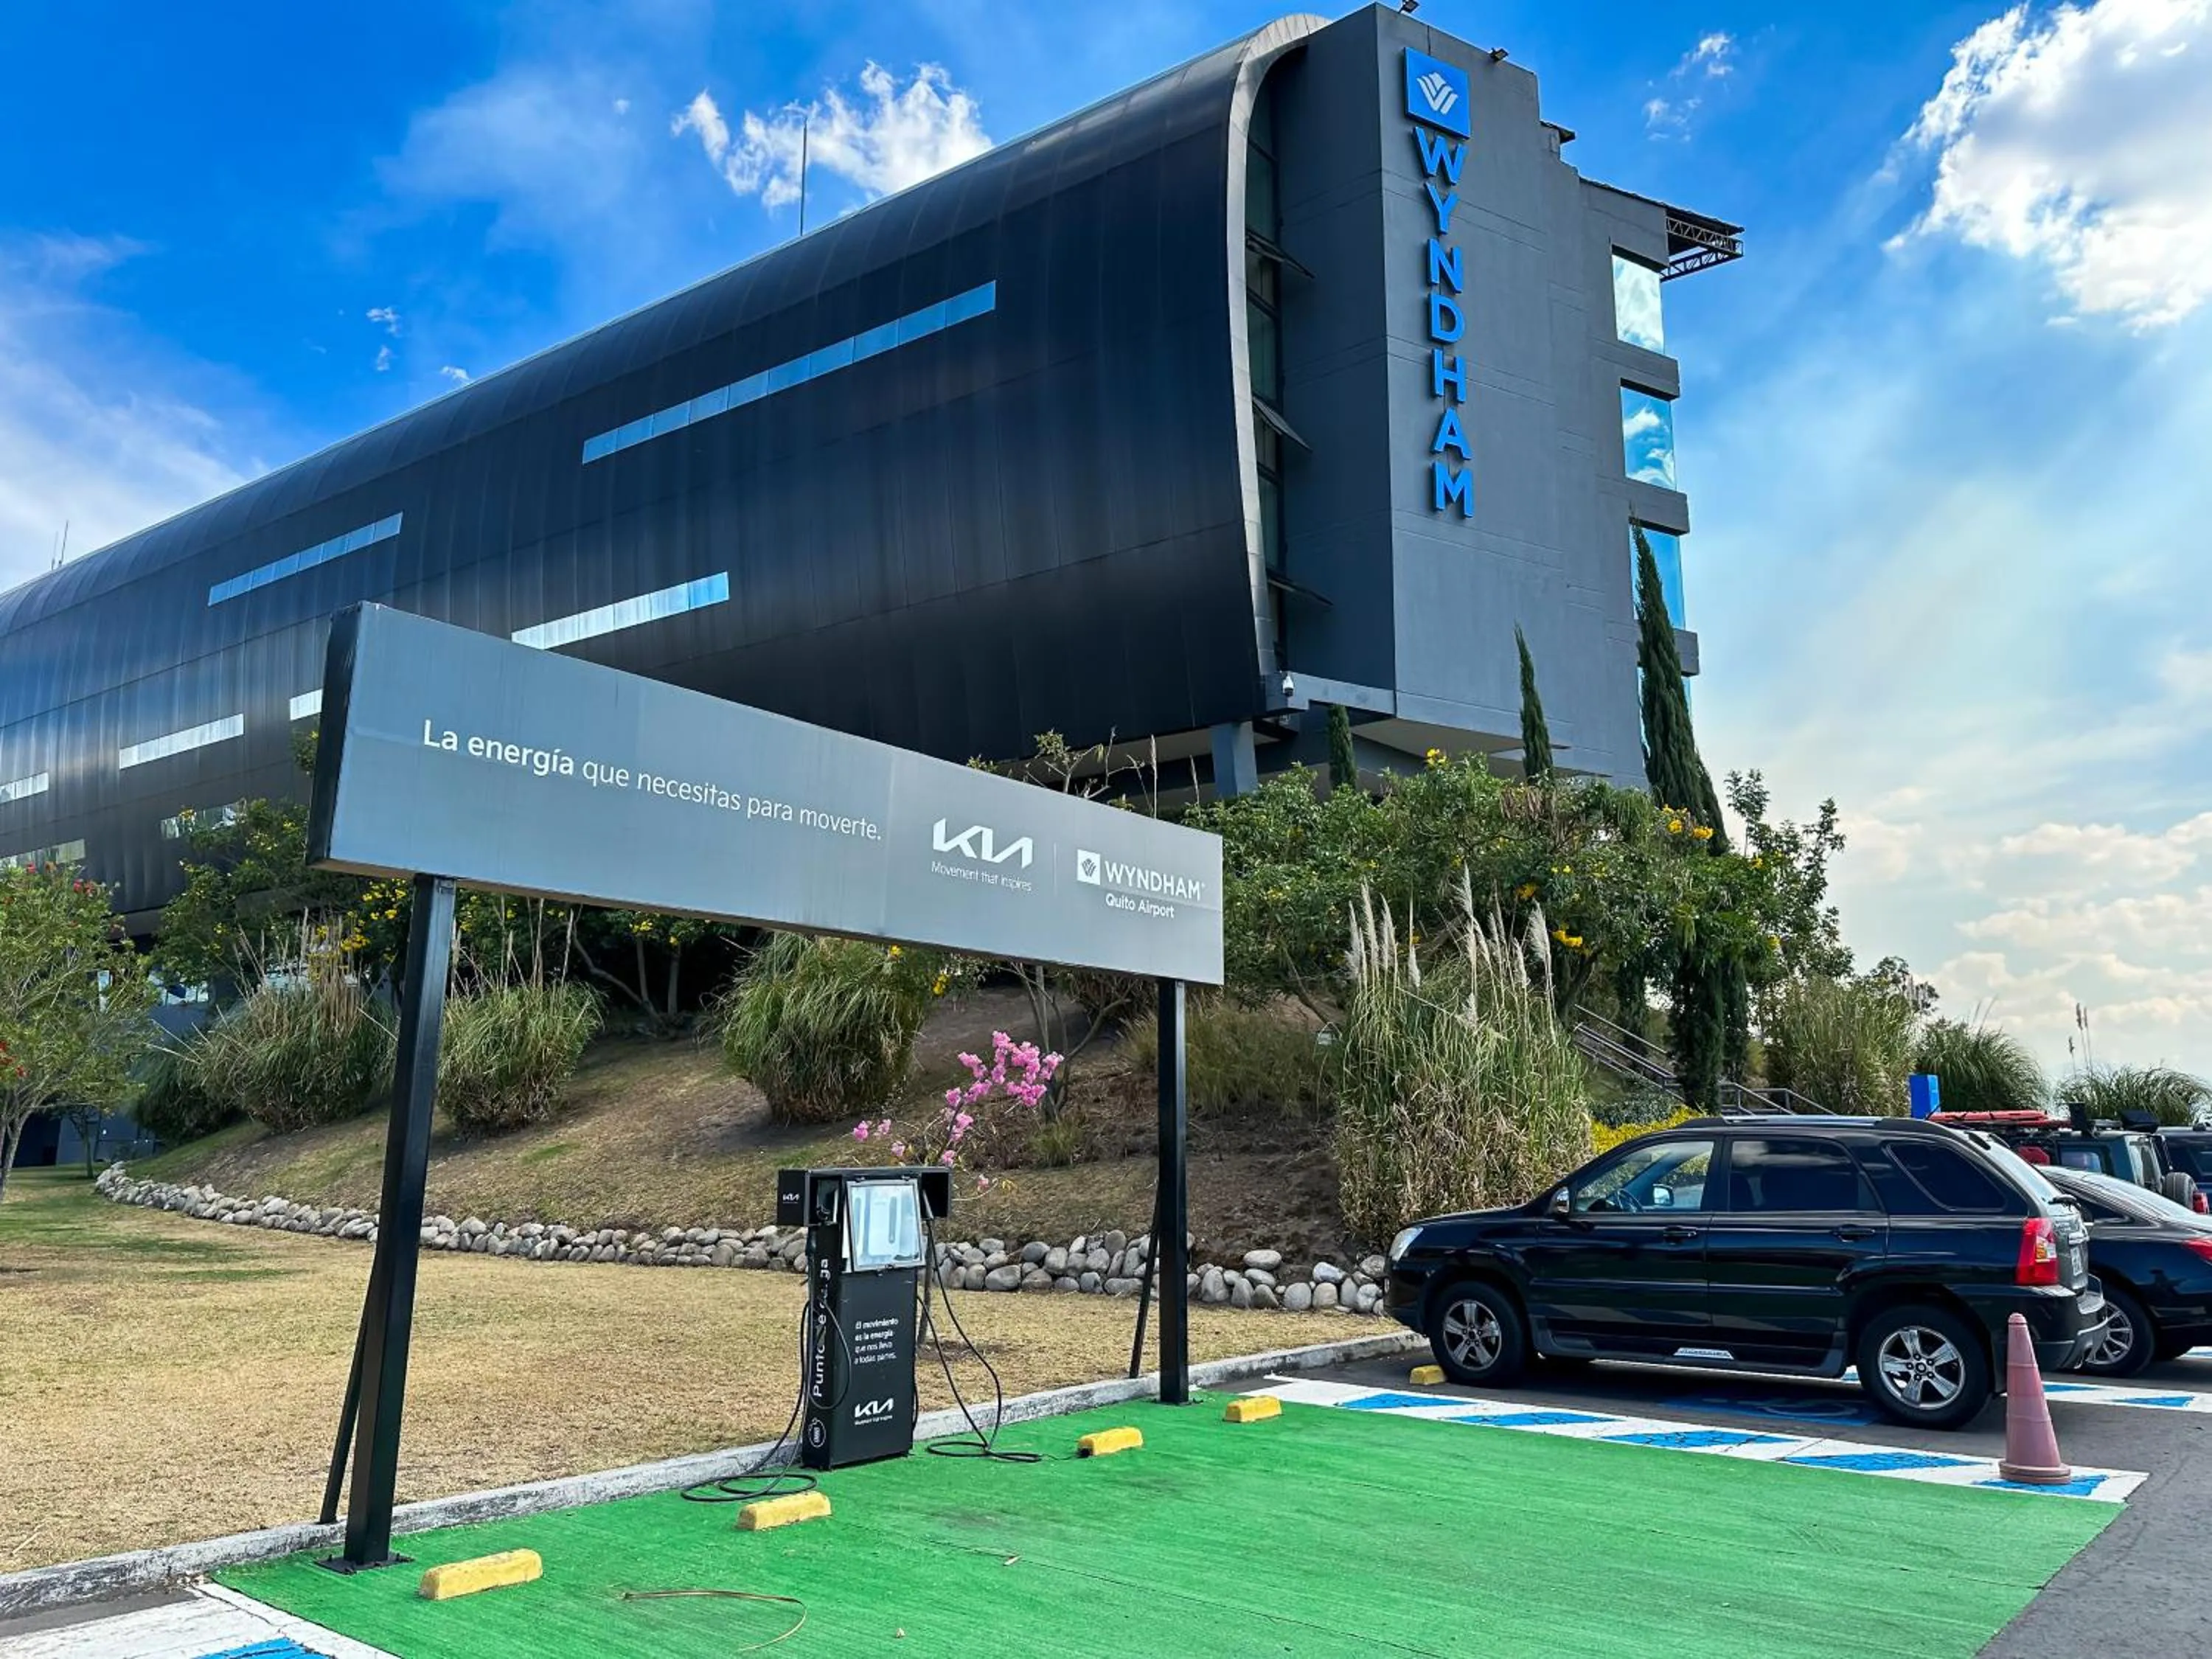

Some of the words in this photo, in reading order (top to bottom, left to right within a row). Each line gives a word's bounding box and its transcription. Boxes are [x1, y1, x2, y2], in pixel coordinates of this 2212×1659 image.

[1413, 125, 1474, 518] WYNDHAM
[423, 719, 459, 751] La
[467, 735, 574, 776] energía
[582, 760, 630, 787] que
[637, 772, 741, 811] necesitas
[747, 795, 793, 821] para
[800, 807, 882, 841] moverte.
[933, 818, 1032, 869] KIA
[931, 860, 978, 881] Movement
[981, 870, 998, 884] that
[1105, 860, 1201, 901] WYNDHAM
[1106, 892, 1135, 911] Quito
[1138, 899, 1175, 919] Airport
[855, 1398, 894, 1417] KIA
